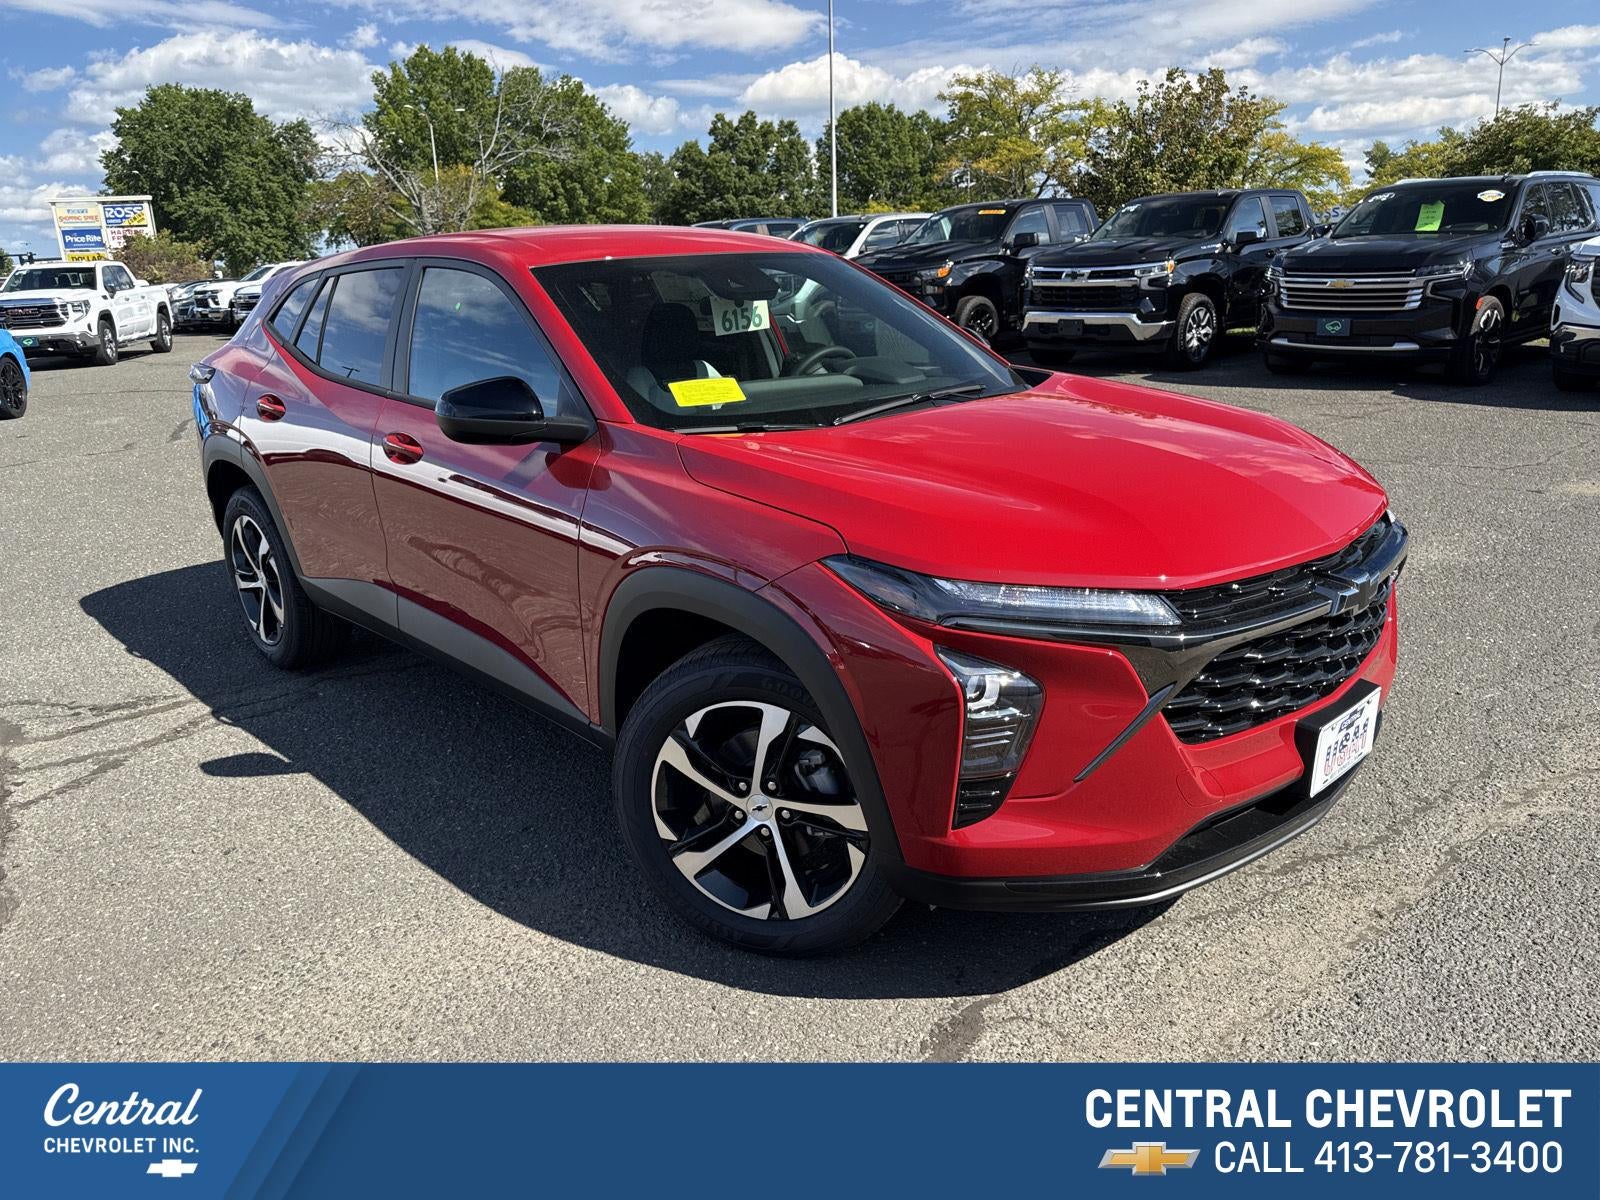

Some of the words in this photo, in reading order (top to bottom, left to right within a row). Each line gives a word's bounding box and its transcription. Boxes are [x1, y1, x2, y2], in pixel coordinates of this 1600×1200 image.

[104, 206, 142, 218] ROSS
[65, 234, 86, 243] Price
[86, 234, 102, 242] Rite
[721, 306, 763, 332] 6156
